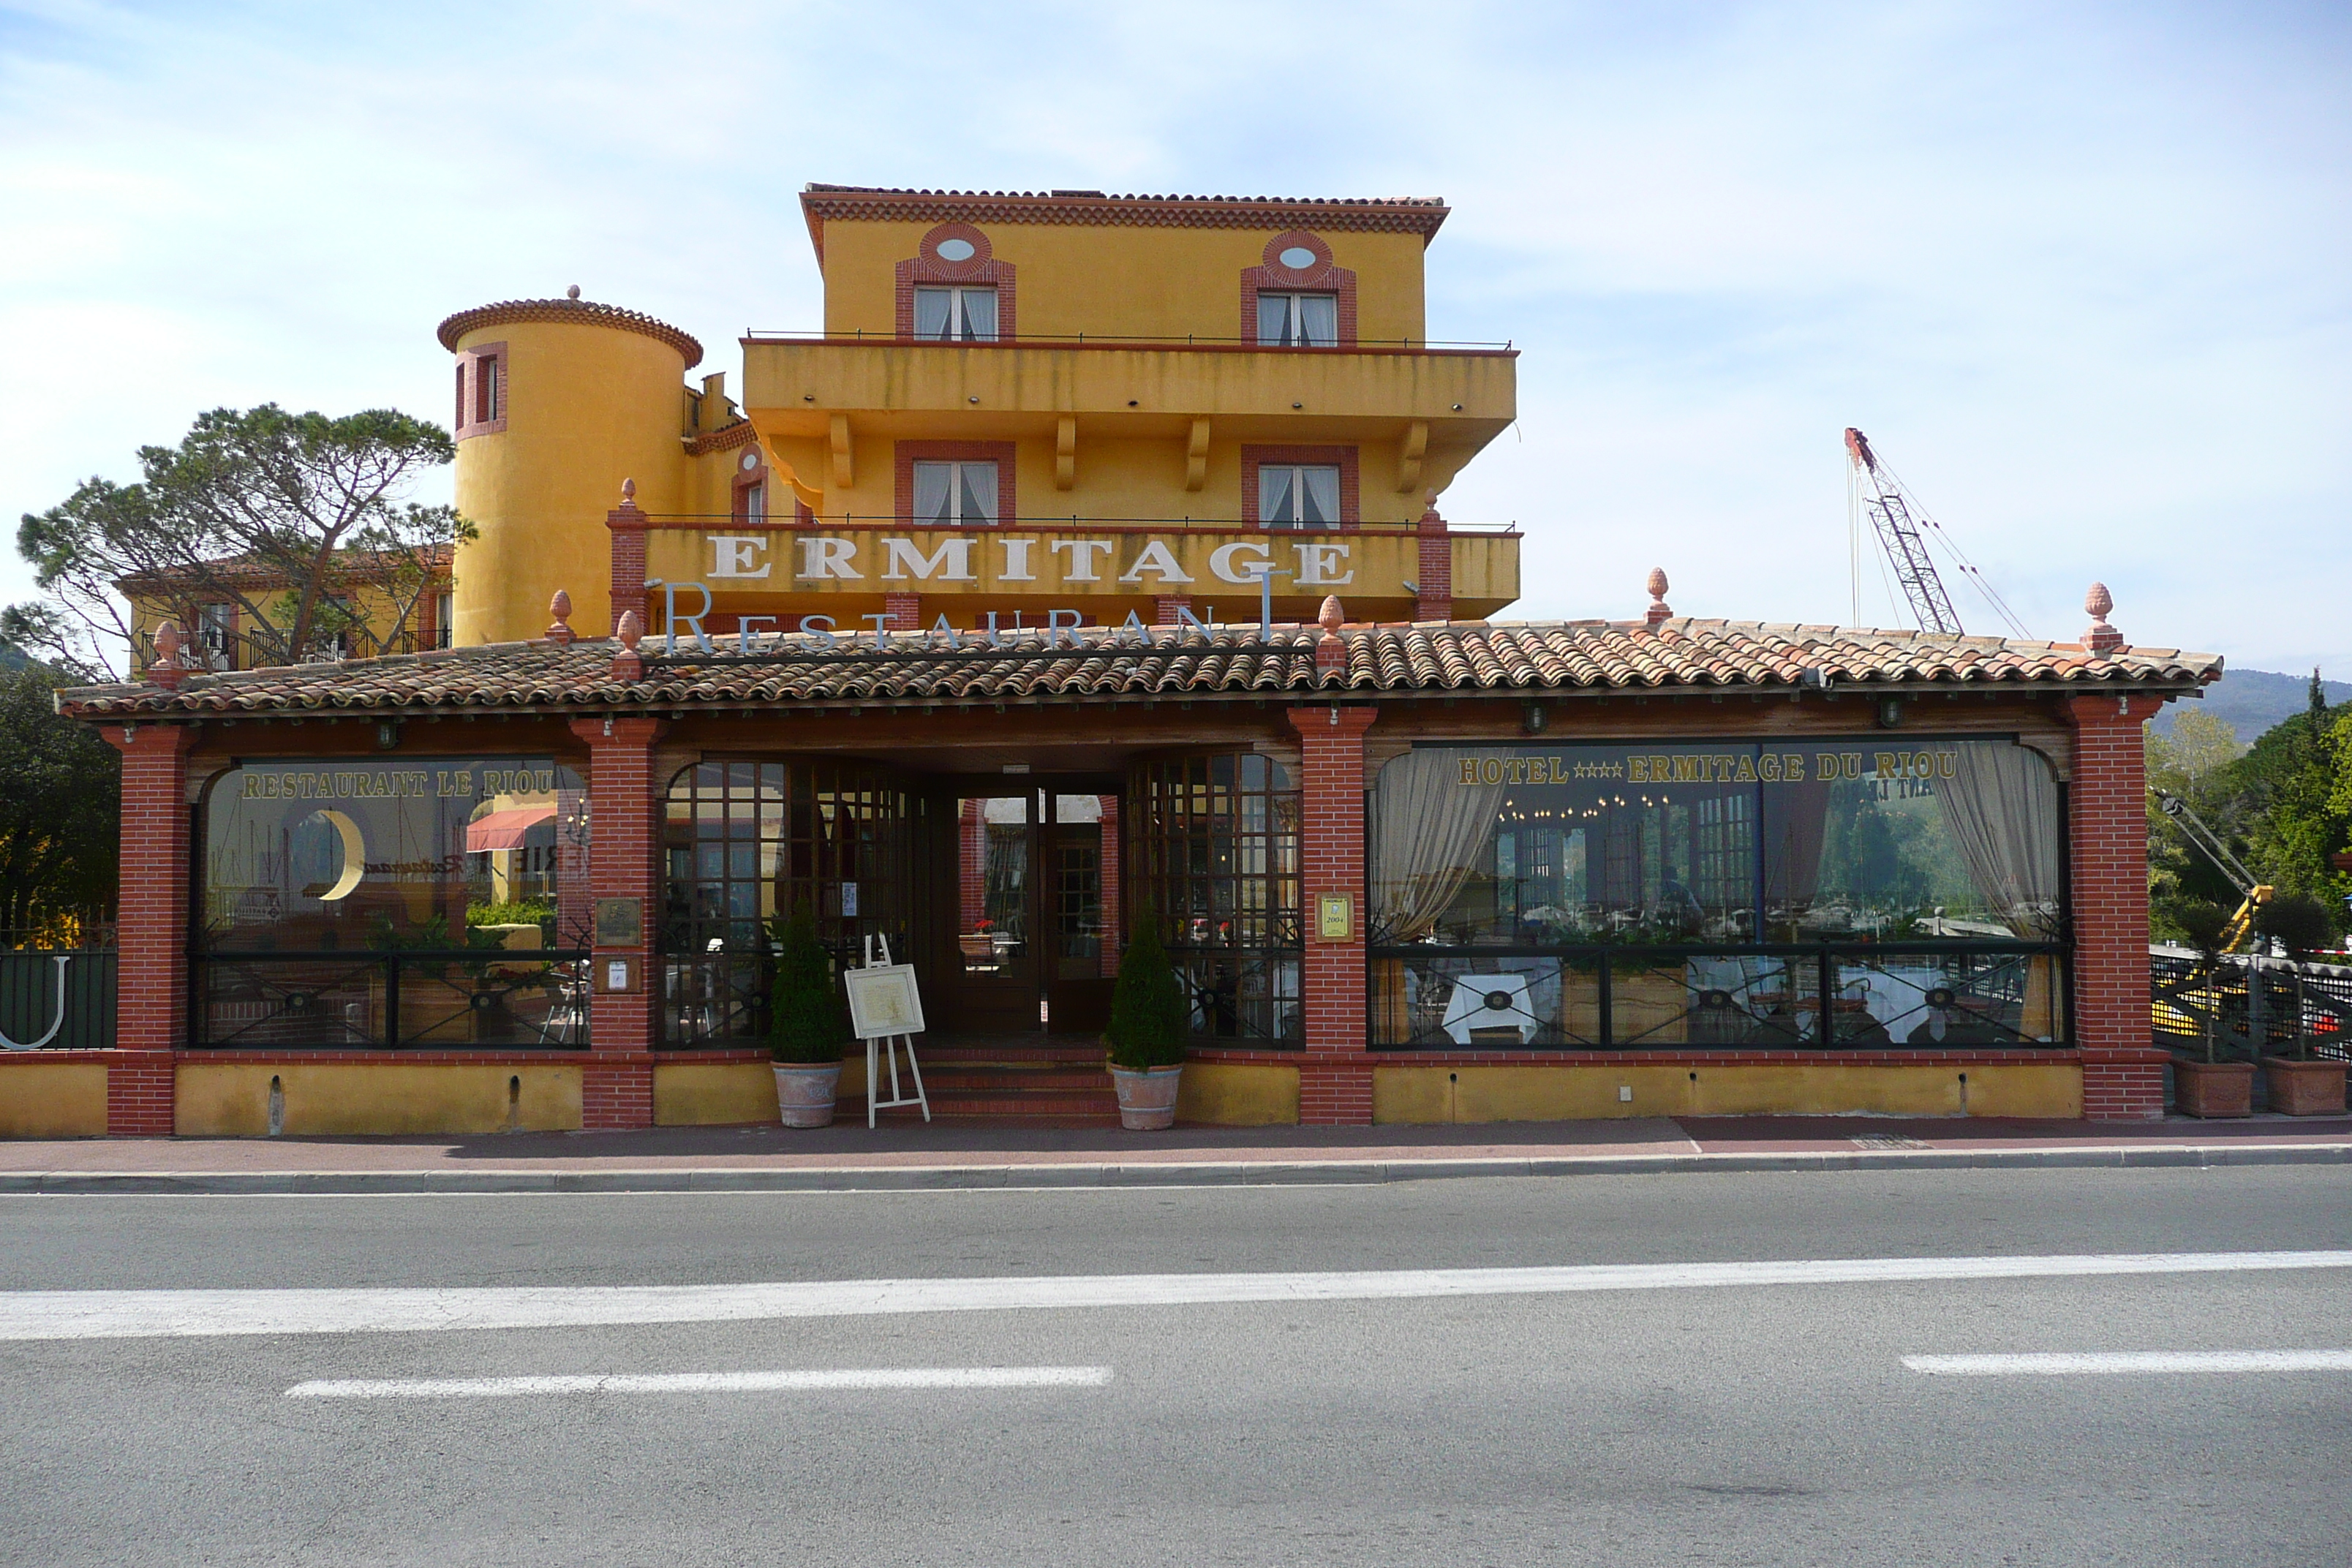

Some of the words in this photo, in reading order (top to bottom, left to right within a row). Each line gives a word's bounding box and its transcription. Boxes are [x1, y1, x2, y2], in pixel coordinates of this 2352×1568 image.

[706, 535, 1354, 584] ERMITAGE
[666, 568, 1293, 655] RESTAURANT
[242, 771, 428, 799] RESTAURANT
[437, 771, 472, 796] LE
[483, 770, 554, 796] RIOU
[1458, 757, 1569, 785] HOTEL
[1627, 753, 1804, 783] ERMITAGE
[1817, 753, 1861, 781] DU
[1874, 752, 1957, 780] RIOU
